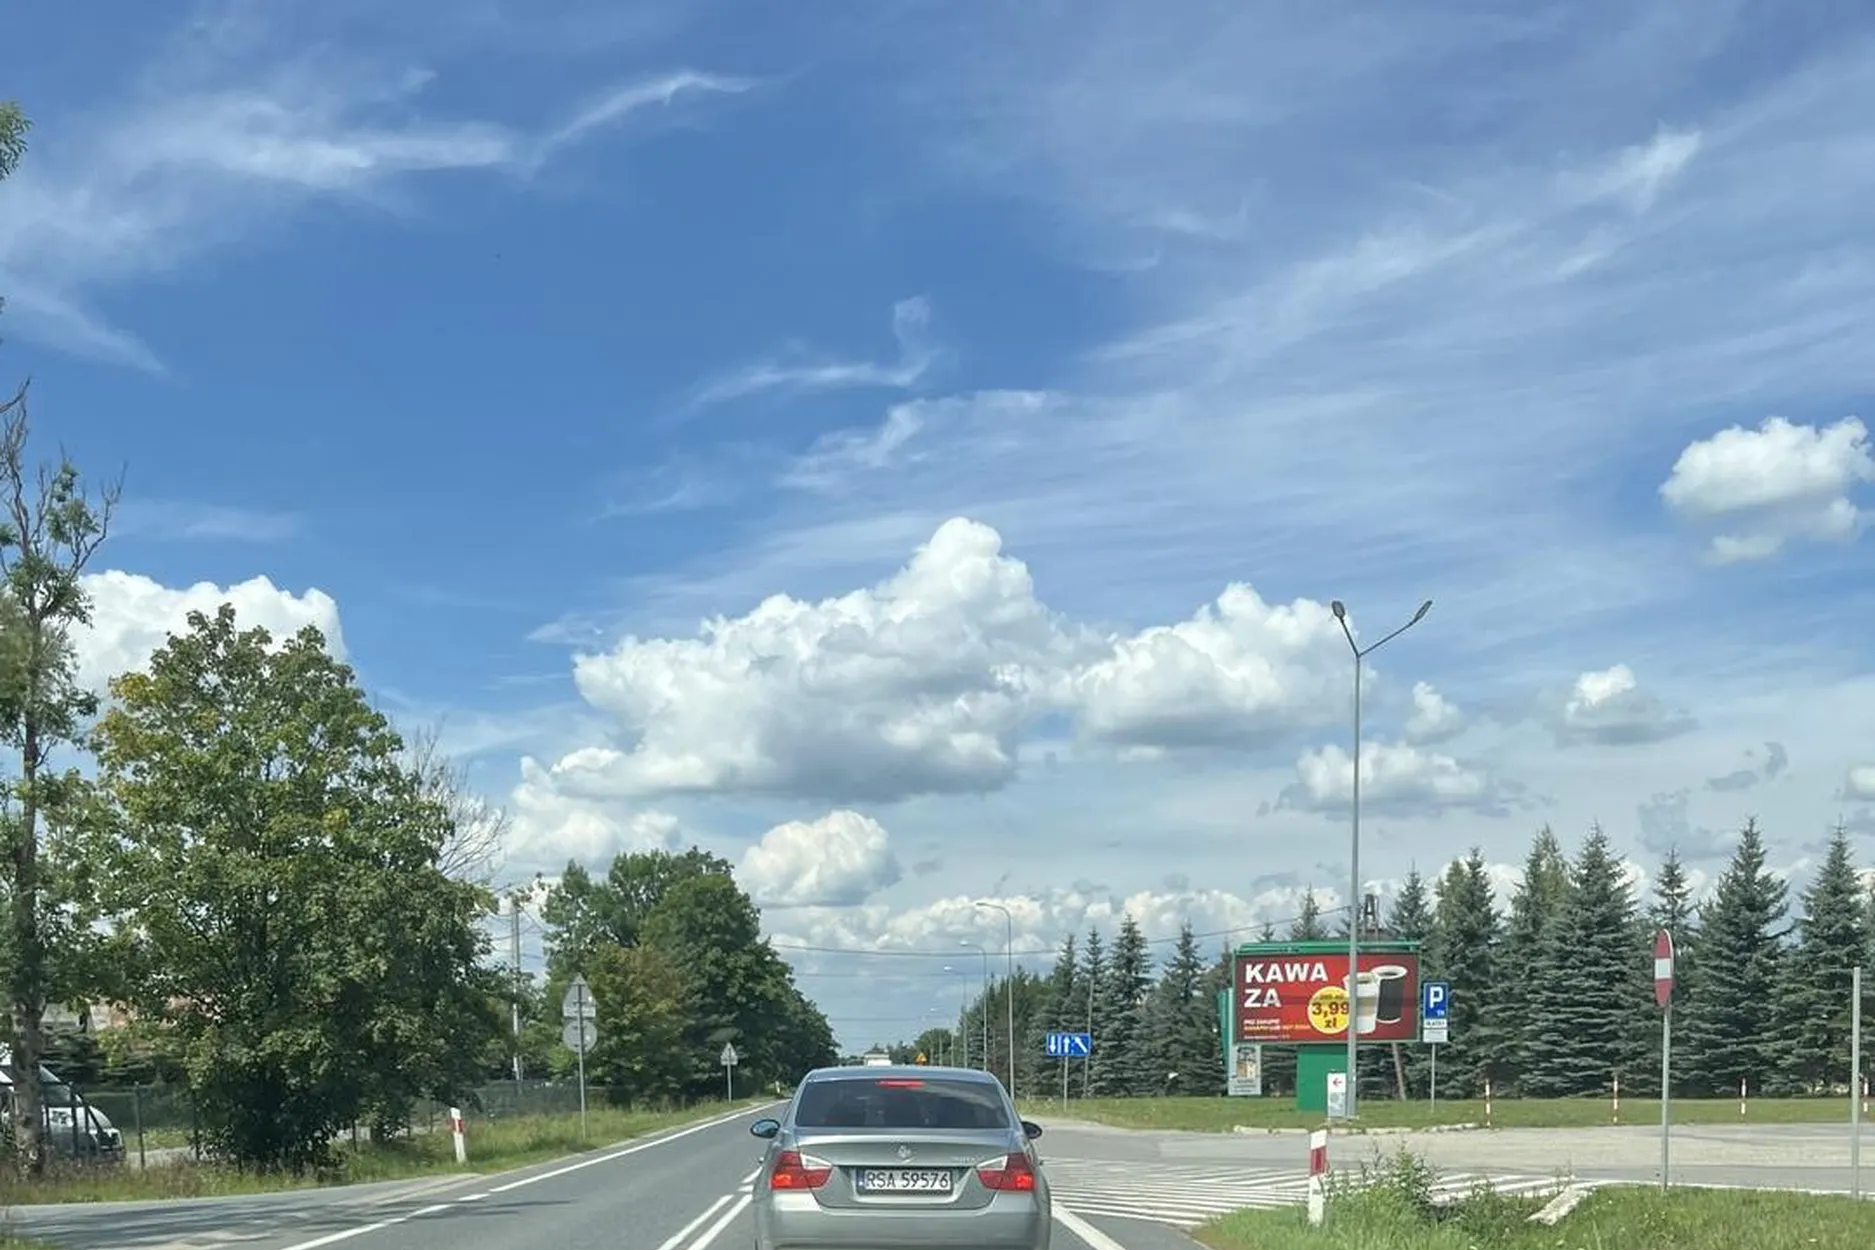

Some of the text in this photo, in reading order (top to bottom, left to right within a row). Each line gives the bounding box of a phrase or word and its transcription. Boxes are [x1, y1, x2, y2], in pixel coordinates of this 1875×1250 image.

[1245, 963, 1328, 983] KAWA
[1244, 989, 1281, 1008] ZA
[1429, 986, 1444, 1009] P
[1312, 1001, 1349, 1018] 3,99
[866, 1171, 949, 1188] RSA 59576
